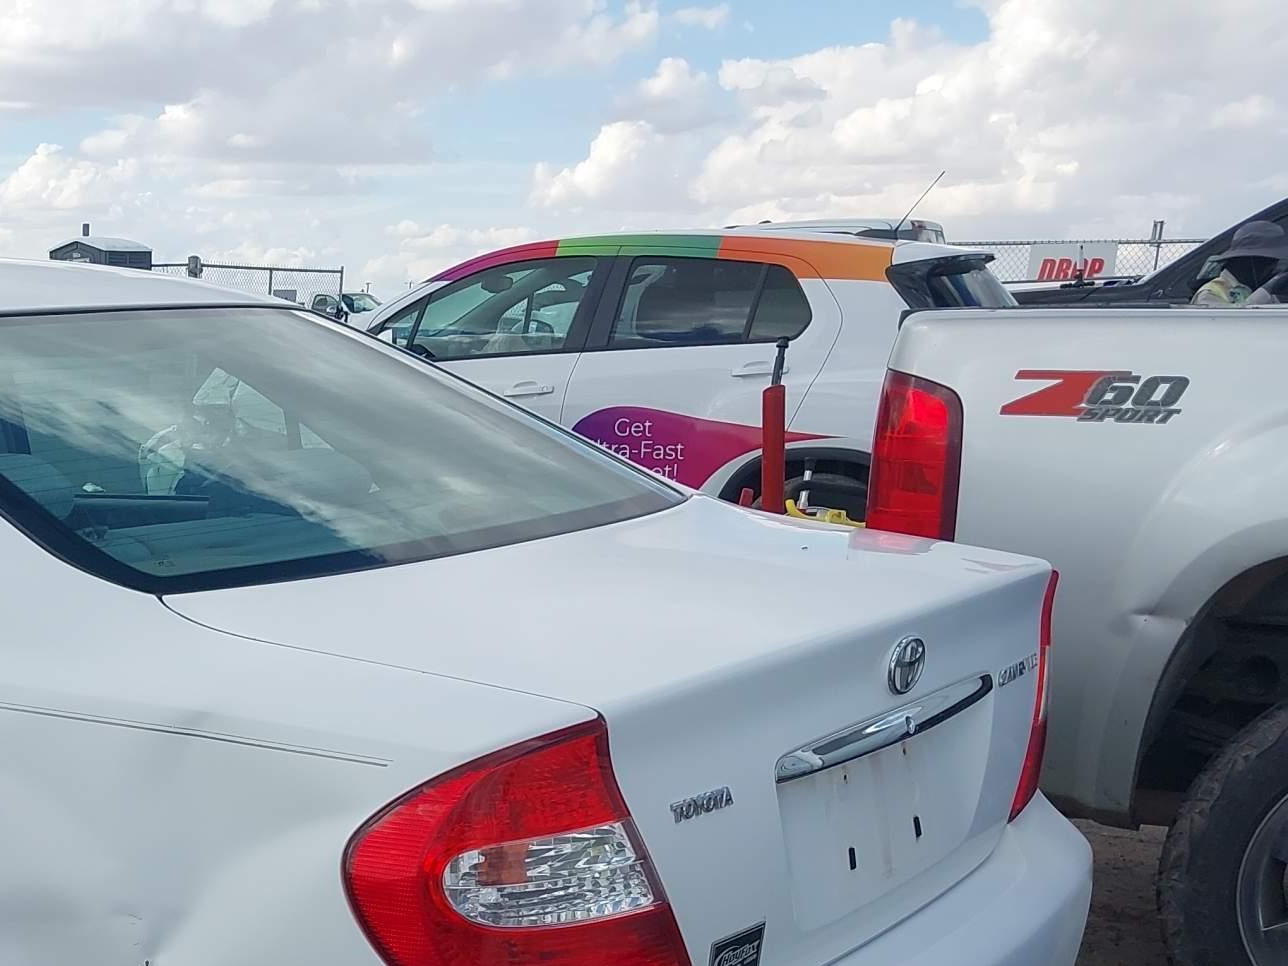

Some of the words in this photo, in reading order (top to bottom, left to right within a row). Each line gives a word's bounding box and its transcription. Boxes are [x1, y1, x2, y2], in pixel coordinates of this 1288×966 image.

[999, 369, 1191, 417] Z60
[614, 417, 653, 437] Get
[1076, 407, 1183, 425] SPORT
[595, 438, 685, 460] tra-Fast
[669, 786, 735, 824] TOYOTA
